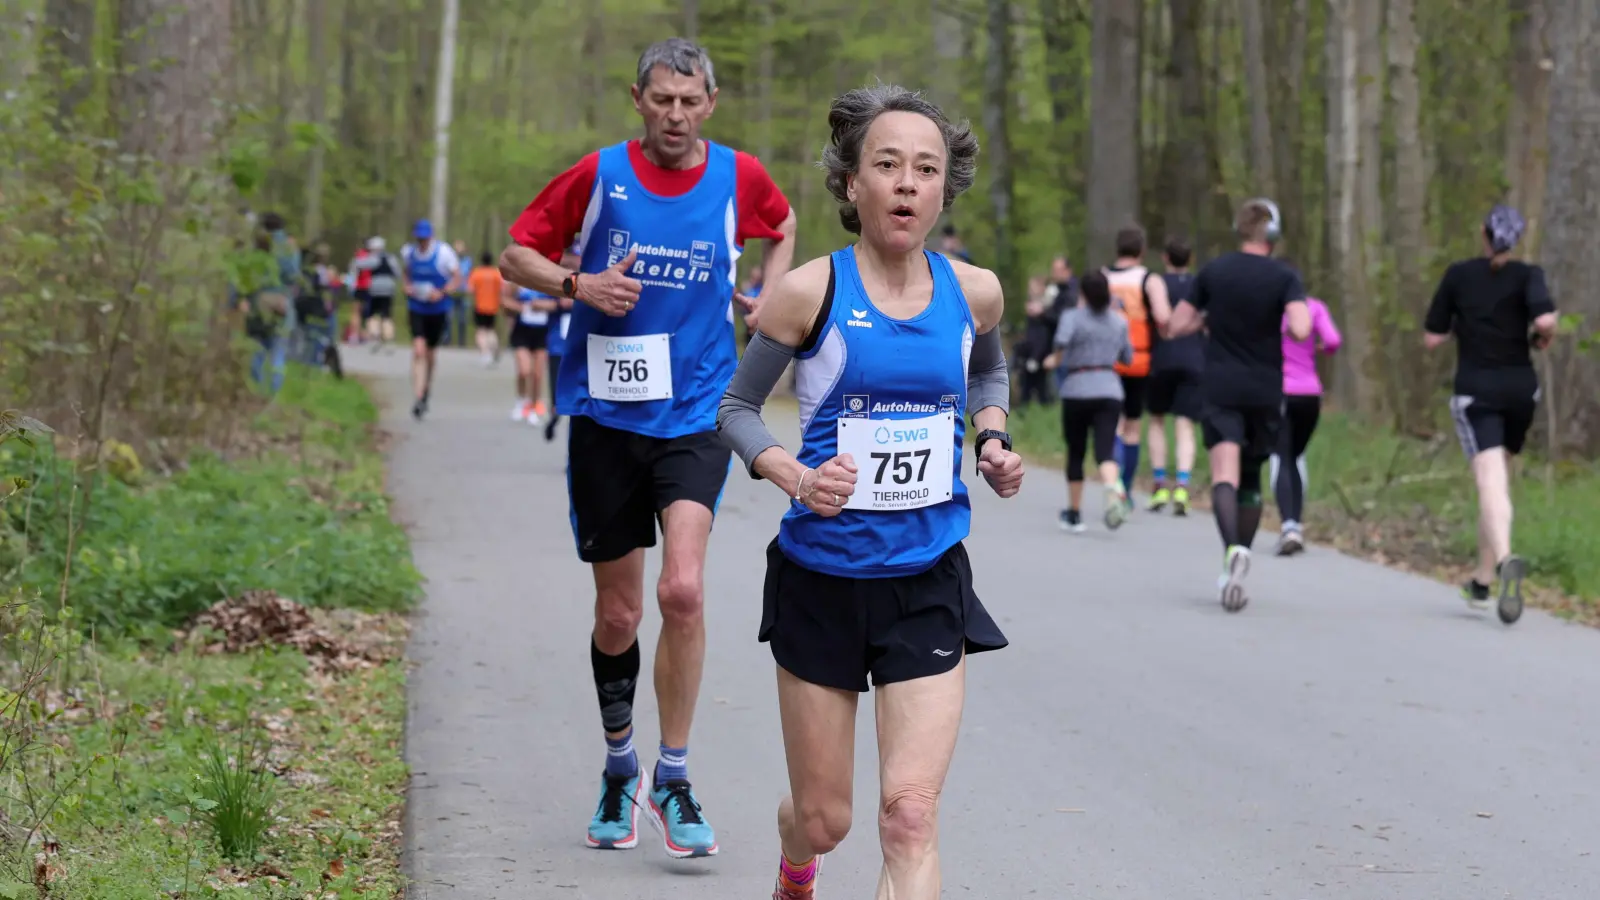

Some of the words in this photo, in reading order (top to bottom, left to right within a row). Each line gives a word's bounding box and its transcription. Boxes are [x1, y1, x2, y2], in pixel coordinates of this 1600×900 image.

[629, 242, 689, 259] Autohaus
[607, 255, 710, 282] Eßelein
[847, 320, 872, 328] erima
[616, 343, 643, 353] swa
[604, 359, 649, 383] 756
[607, 386, 649, 395] TIERHOLD
[872, 402, 936, 413] Autohaus
[893, 428, 929, 442] swa
[870, 448, 931, 485] 757
[872, 487, 930, 502] TIERHOLD
